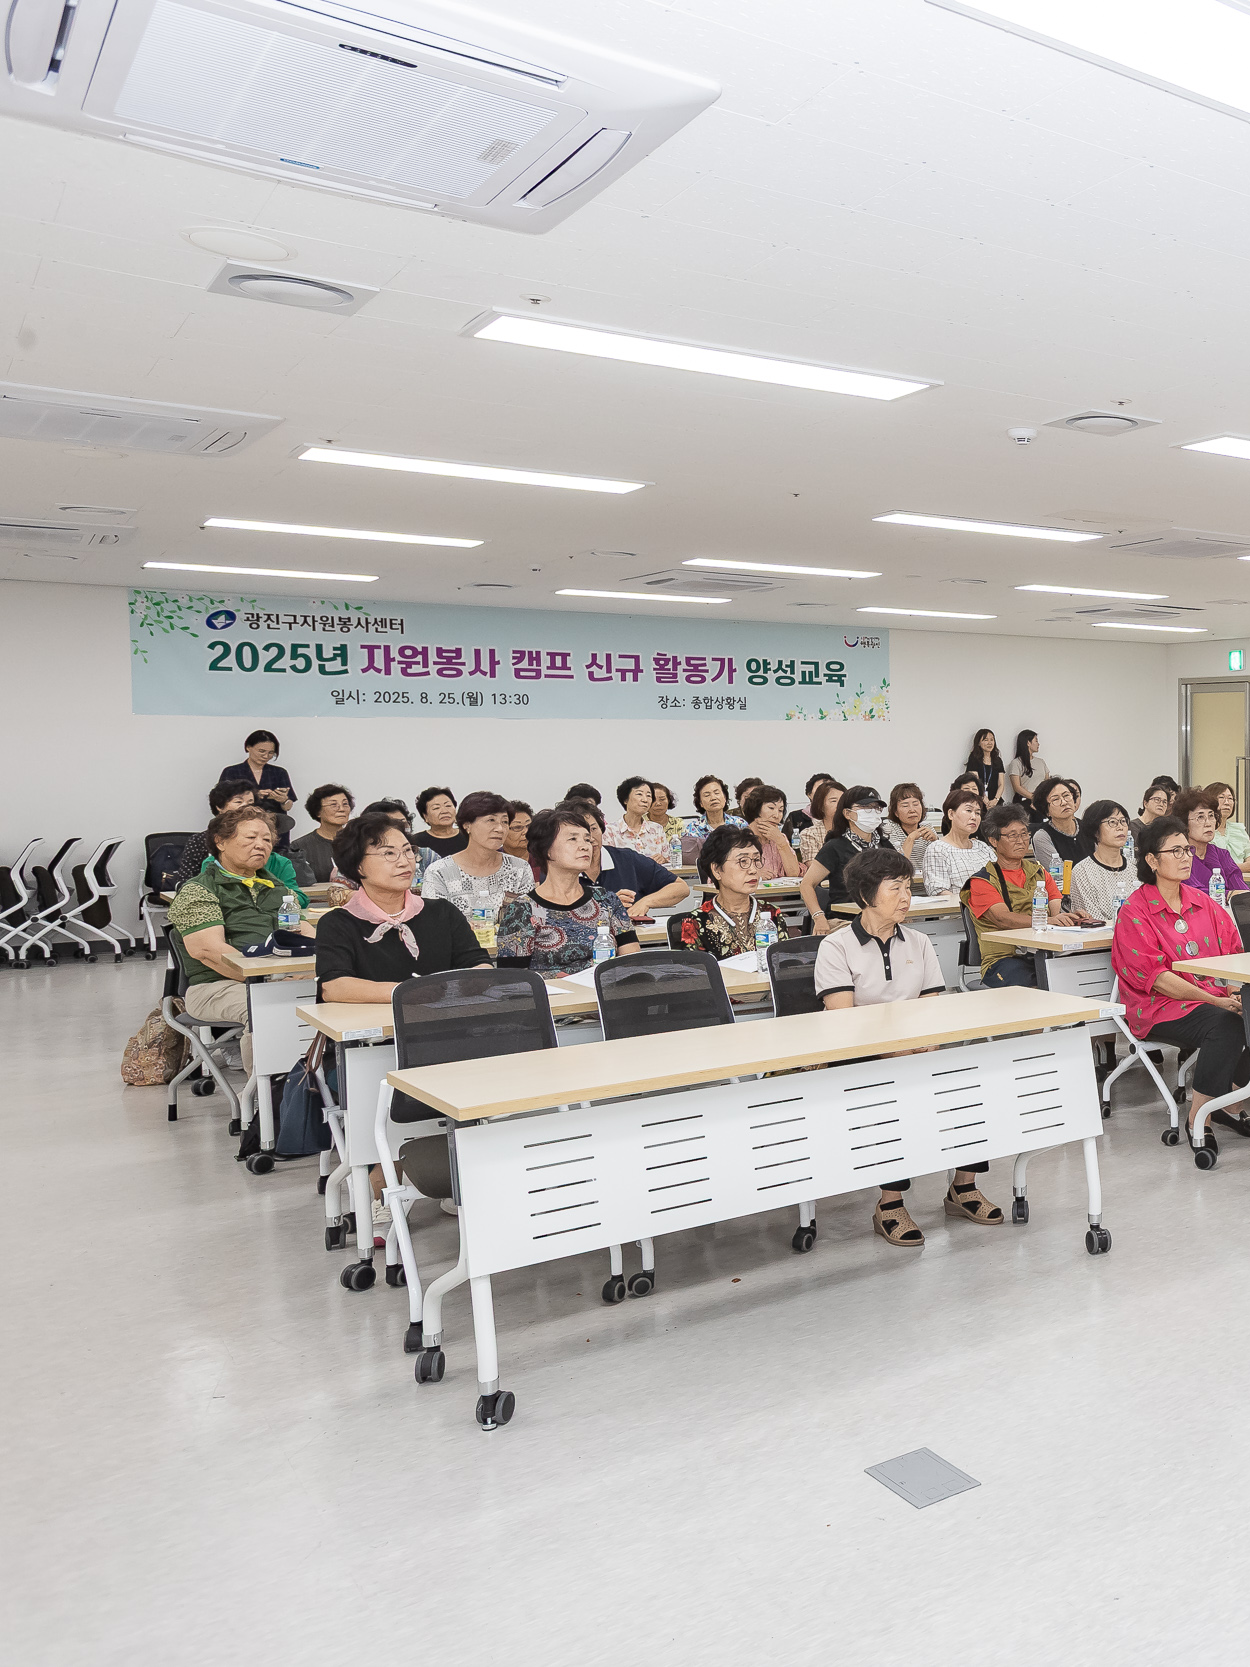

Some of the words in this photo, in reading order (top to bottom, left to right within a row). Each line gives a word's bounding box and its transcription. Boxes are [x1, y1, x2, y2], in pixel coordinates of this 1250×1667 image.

[243, 612, 405, 635] 광진구자원봉사센터
[206, 640, 350, 676] 2025년
[360, 644, 501, 679] 자원봉사
[511, 649, 575, 680] 캠프
[584, 652, 644, 683] 신규
[652, 652, 737, 685] 활동가
[745, 657, 847, 688] 양성교육
[330, 688, 366, 705] 일시:
[373, 690, 414, 704] 2025.
[420, 691, 433, 704] 8.
[438, 691, 484, 706] 25.(월)
[491, 693, 530, 705] 13:30
[657, 695, 686, 709] 장소:
[690, 695, 747, 711] 종합상황실
